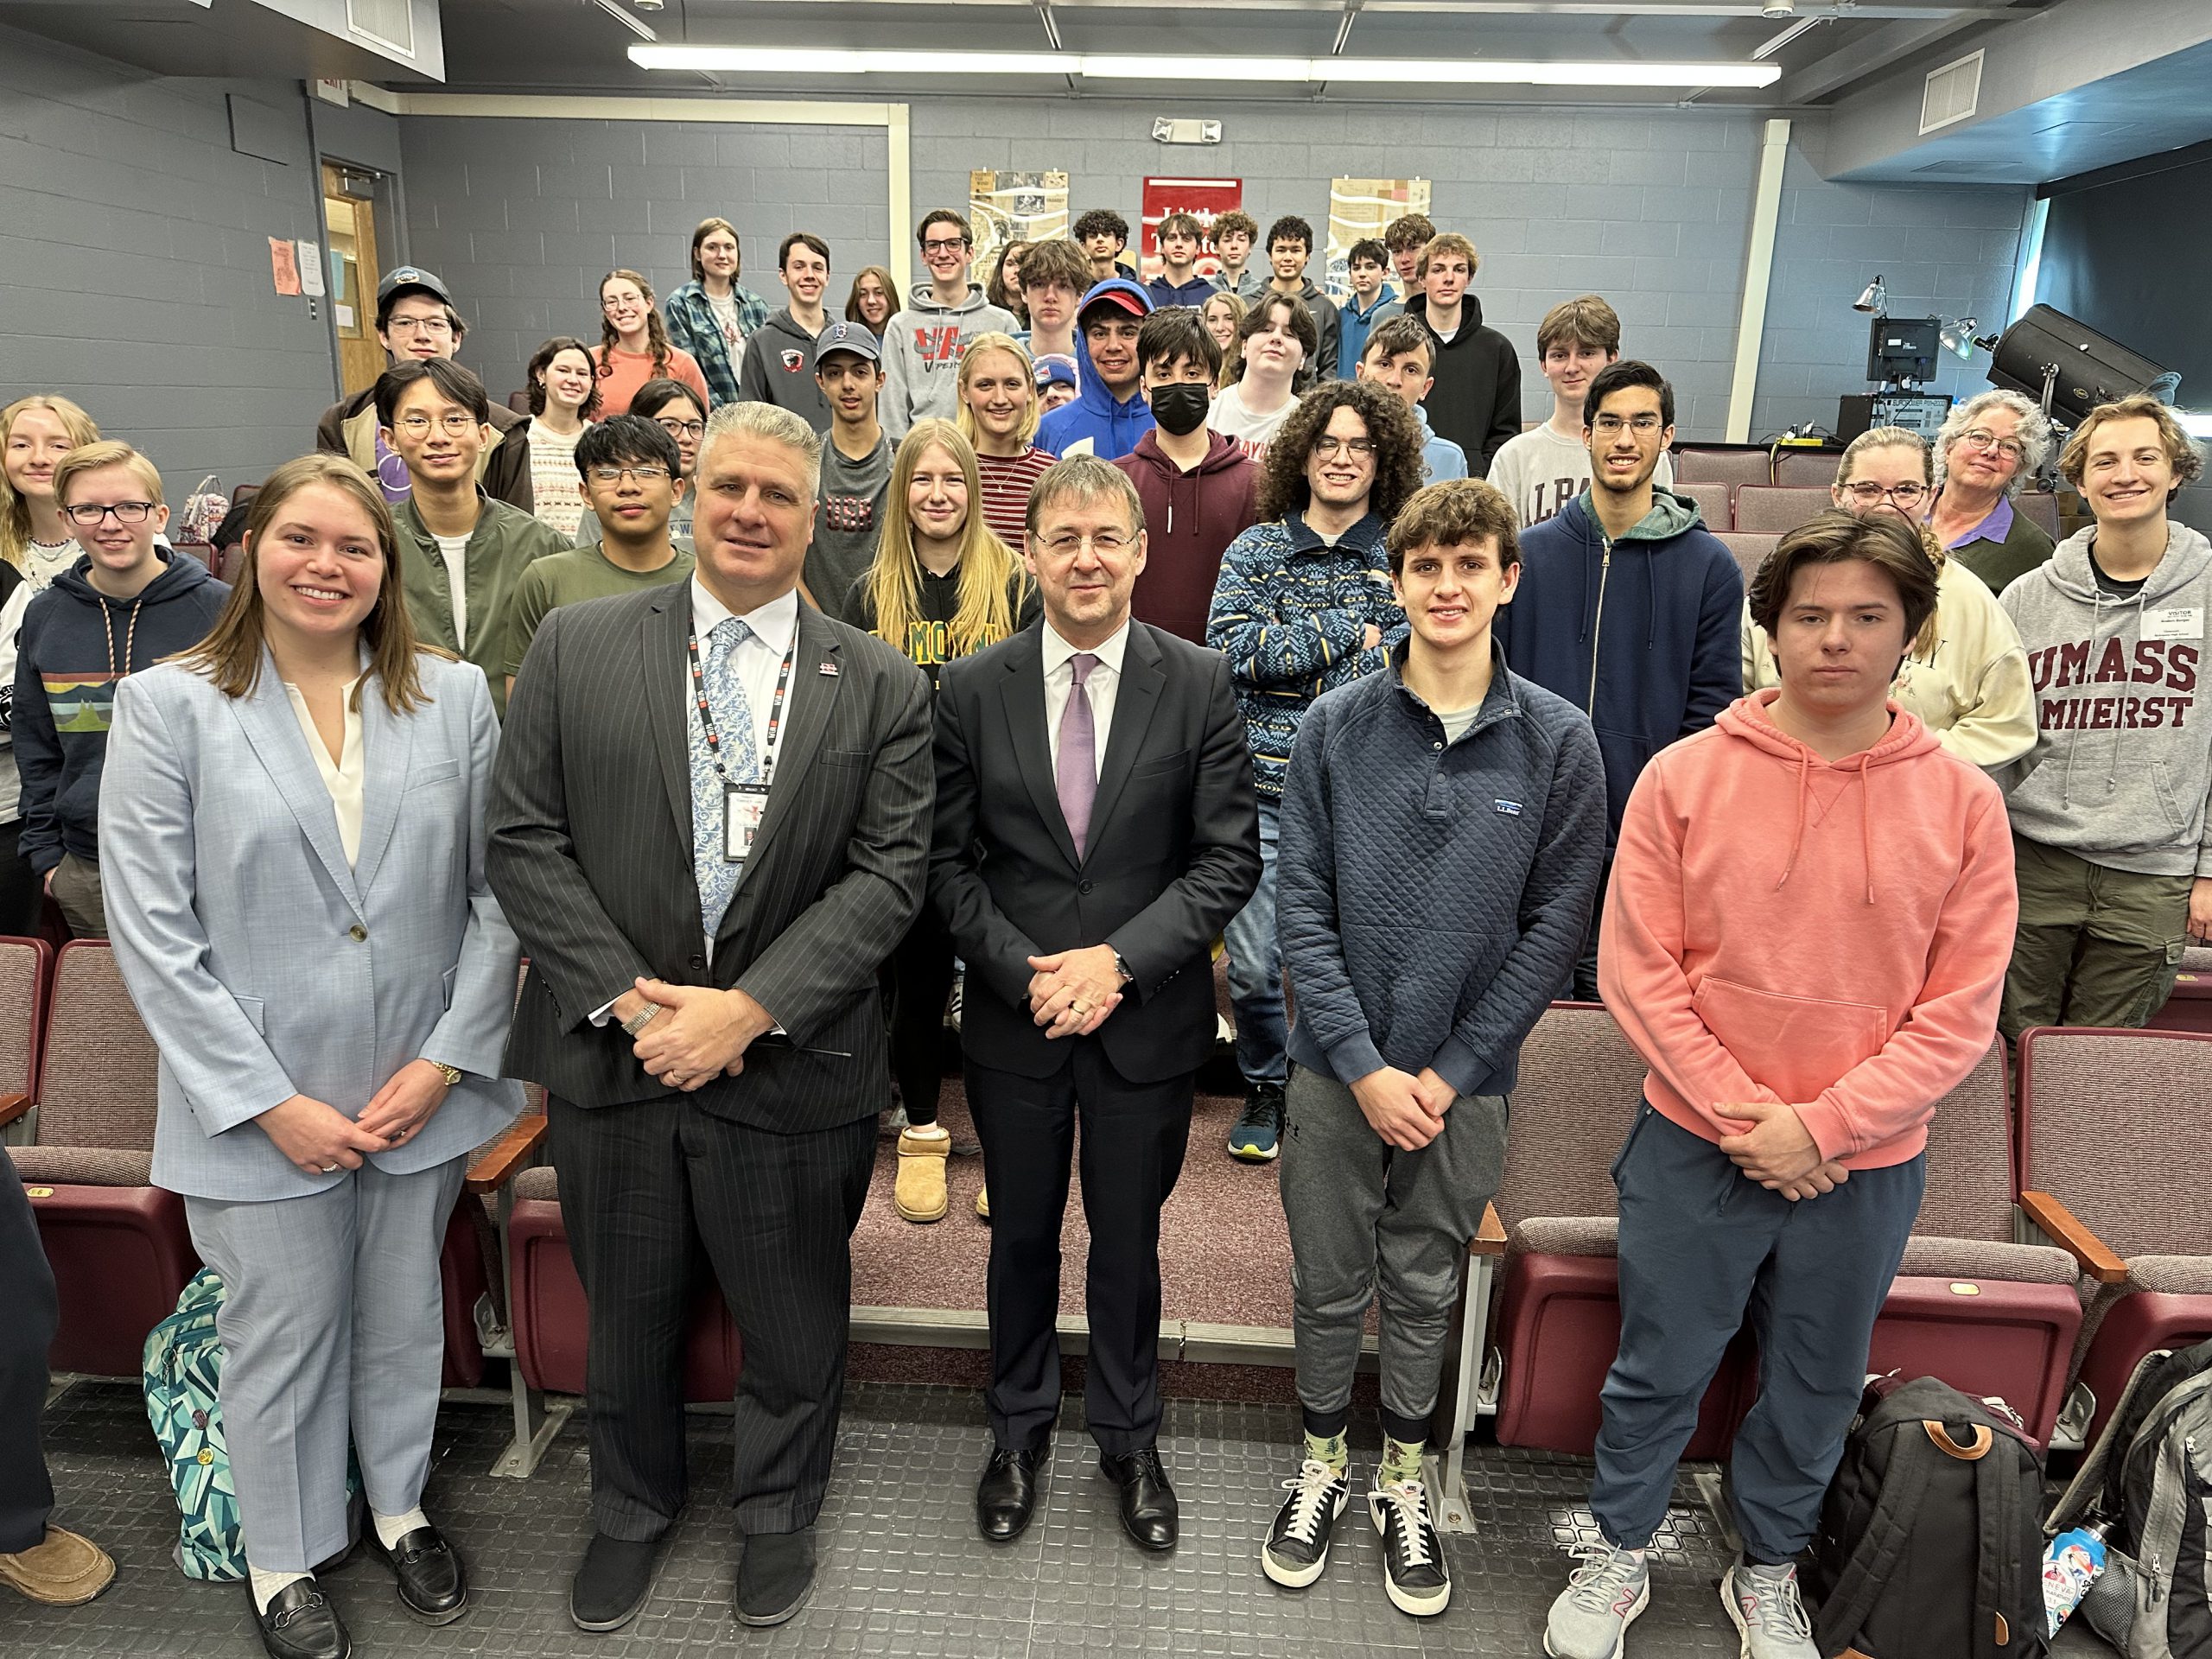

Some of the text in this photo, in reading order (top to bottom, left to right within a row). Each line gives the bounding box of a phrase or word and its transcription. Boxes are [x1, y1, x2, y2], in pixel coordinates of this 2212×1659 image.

[1162, 207, 1220, 228] Ltle
[826, 497, 873, 531] USA
[2028, 637, 2199, 692] UMASS
[2039, 697, 2194, 730] MHERST
